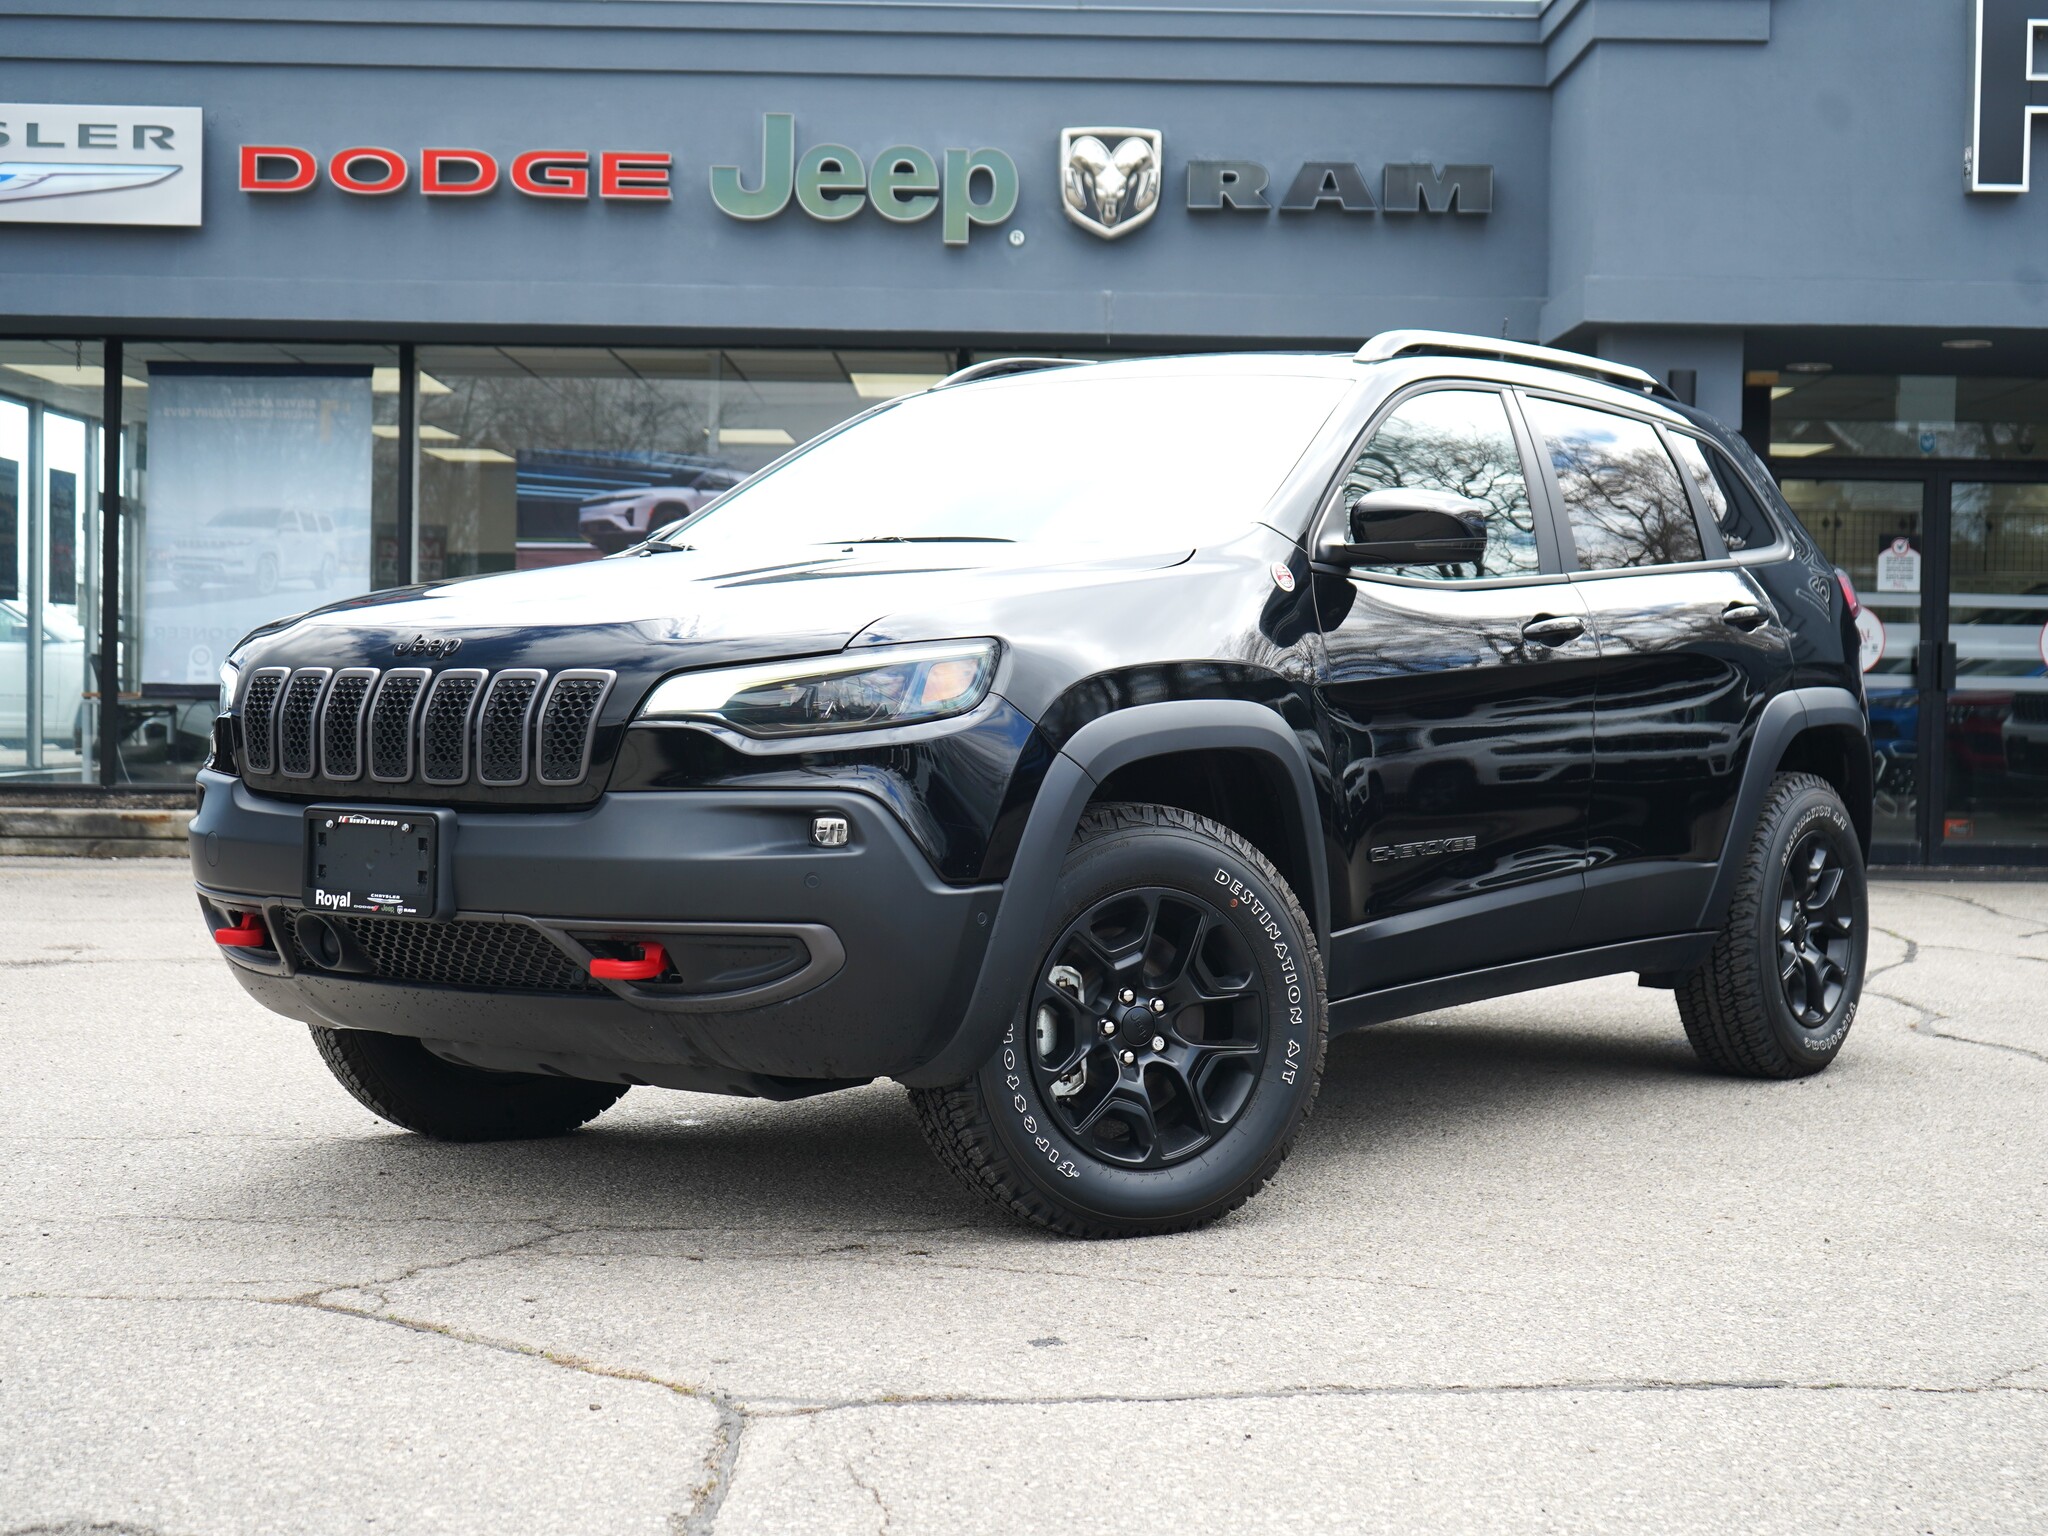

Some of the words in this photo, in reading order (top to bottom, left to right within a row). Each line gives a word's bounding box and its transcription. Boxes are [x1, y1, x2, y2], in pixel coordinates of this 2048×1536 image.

[0, 122, 175, 150] LER
[238, 144, 672, 200] DODGE
[709, 112, 1019, 245] Jeep
[1187, 160, 1495, 214] RAM
[393, 633, 463, 661] Jeep
[1368, 836, 1476, 862] CHEROKEE
[315, 889, 351, 910] Royal
[1214, 868, 1303, 1025] DESTINATION
[1281, 1039, 1300, 1085] A/T
